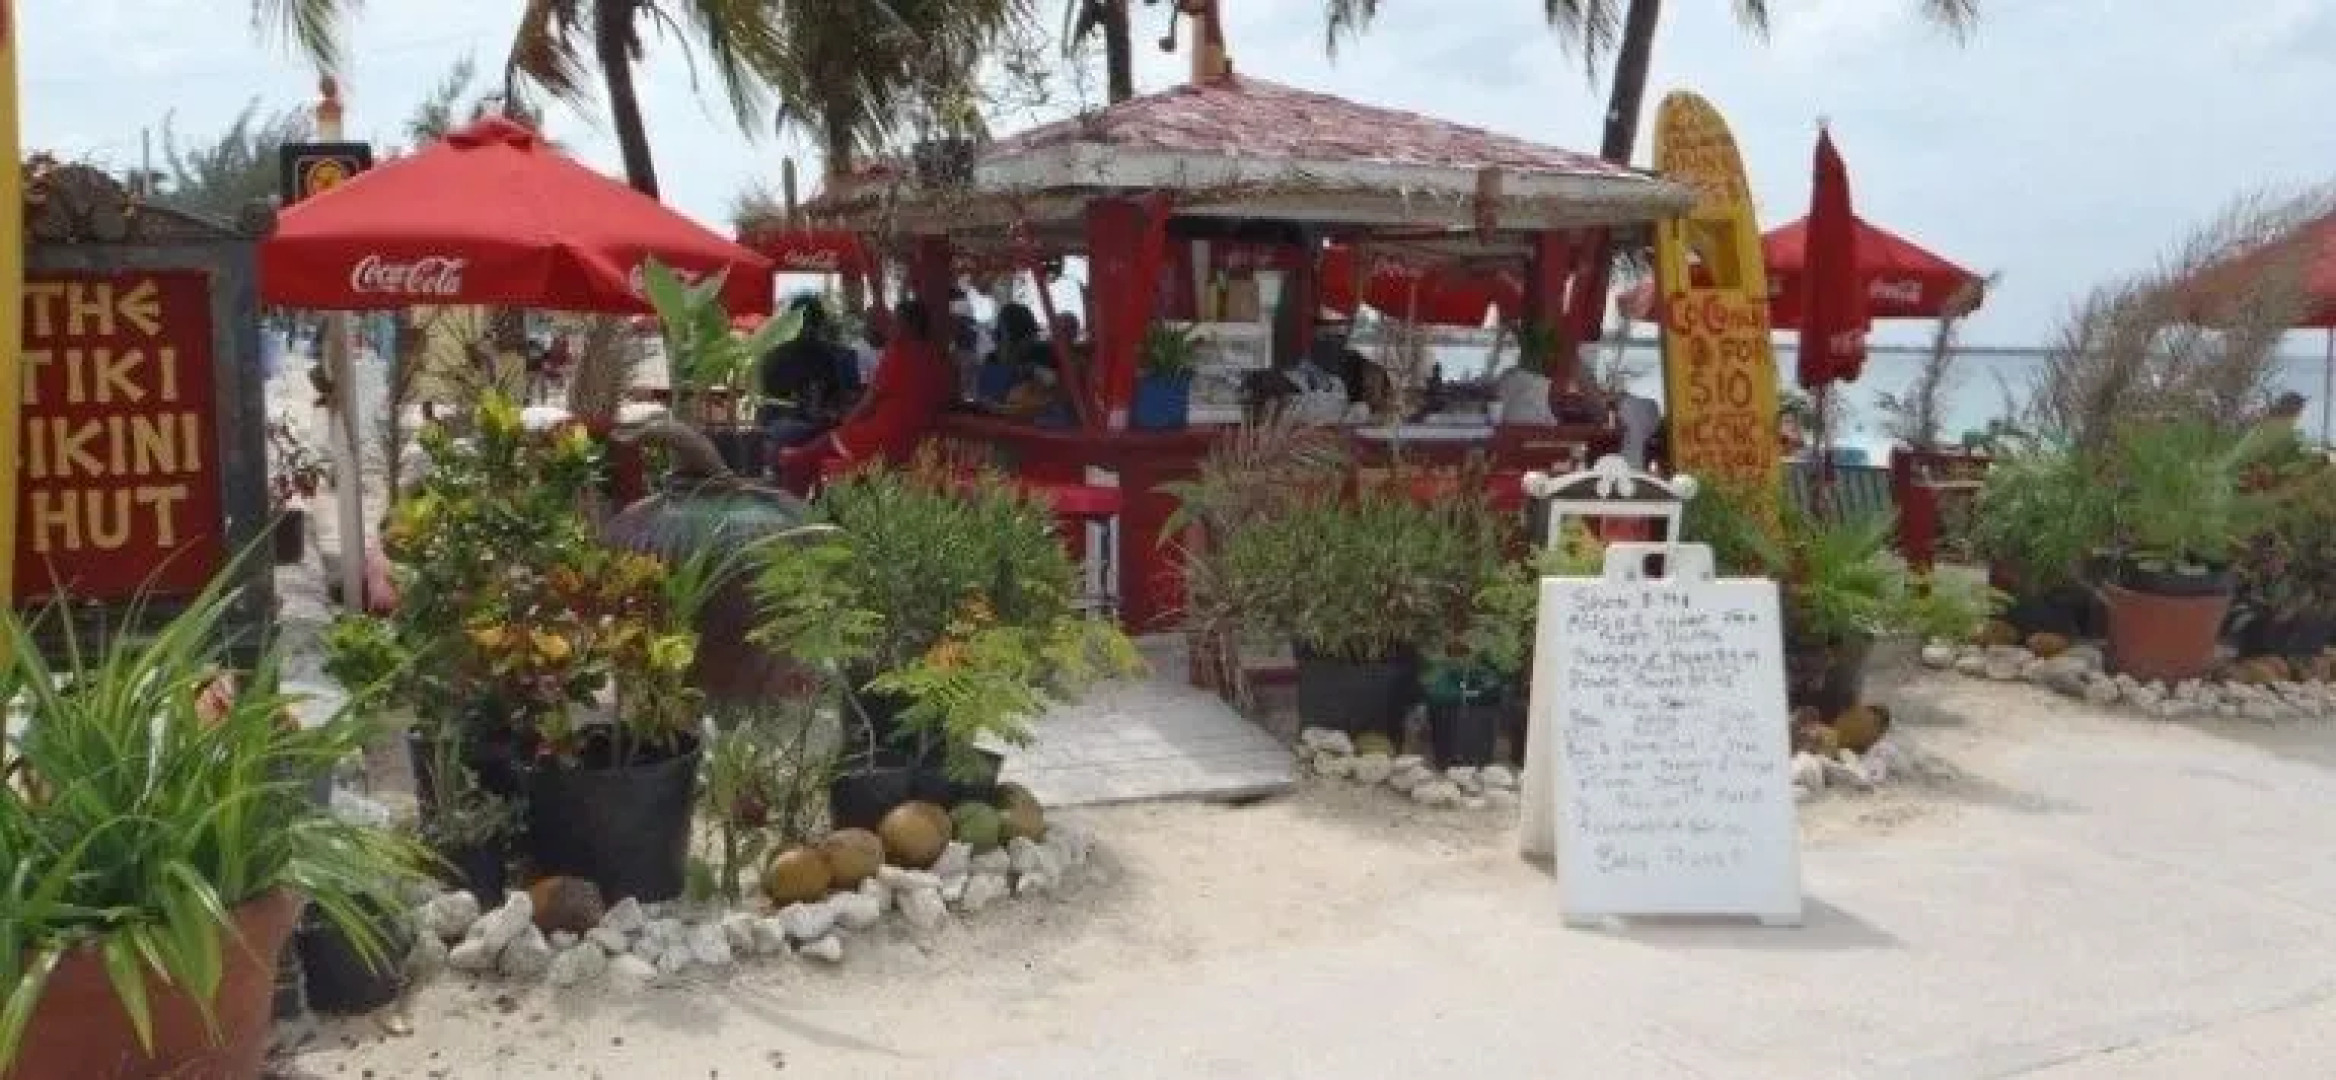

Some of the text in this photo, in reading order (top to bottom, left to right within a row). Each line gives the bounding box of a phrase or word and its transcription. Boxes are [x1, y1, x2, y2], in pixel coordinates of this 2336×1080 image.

[352, 254, 467, 295] Coca-Cola
[22, 280, 161, 335] THE
[19, 347, 178, 404] TIKI
[16, 412, 201, 479] IKINI
[32, 484, 188, 552] HUT
